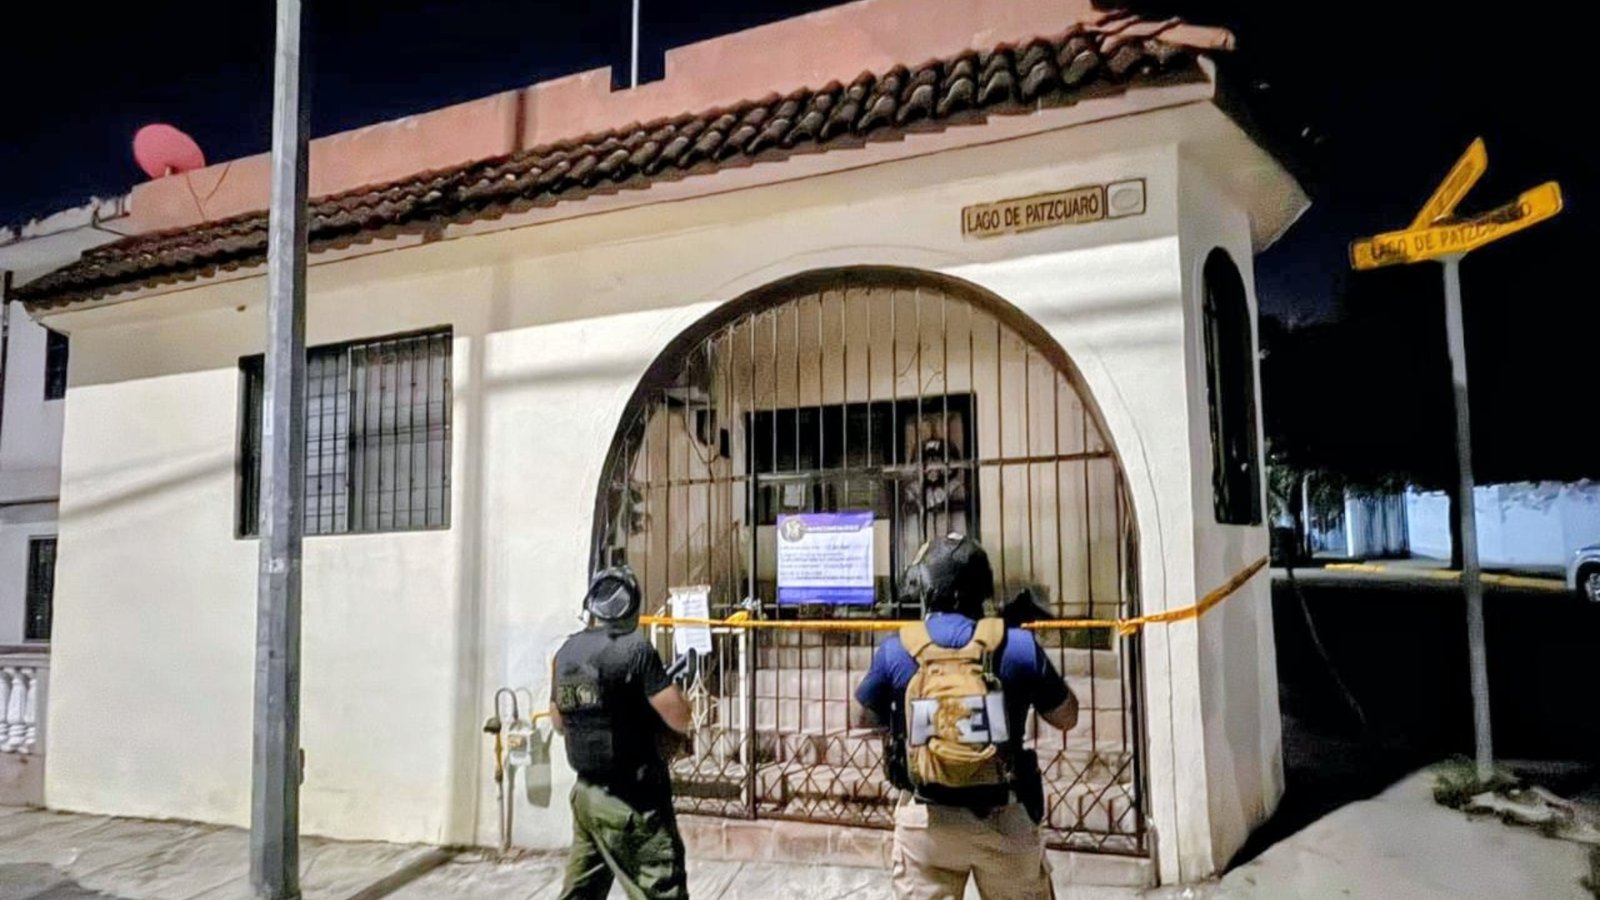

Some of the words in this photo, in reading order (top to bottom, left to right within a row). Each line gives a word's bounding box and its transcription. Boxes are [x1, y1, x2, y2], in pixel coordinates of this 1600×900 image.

[967, 210, 1000, 232] LAGO
[1004, 207, 1021, 226] DE
[1026, 194, 1098, 222] PATZCUARO
[1414, 232, 1435, 252] DE
